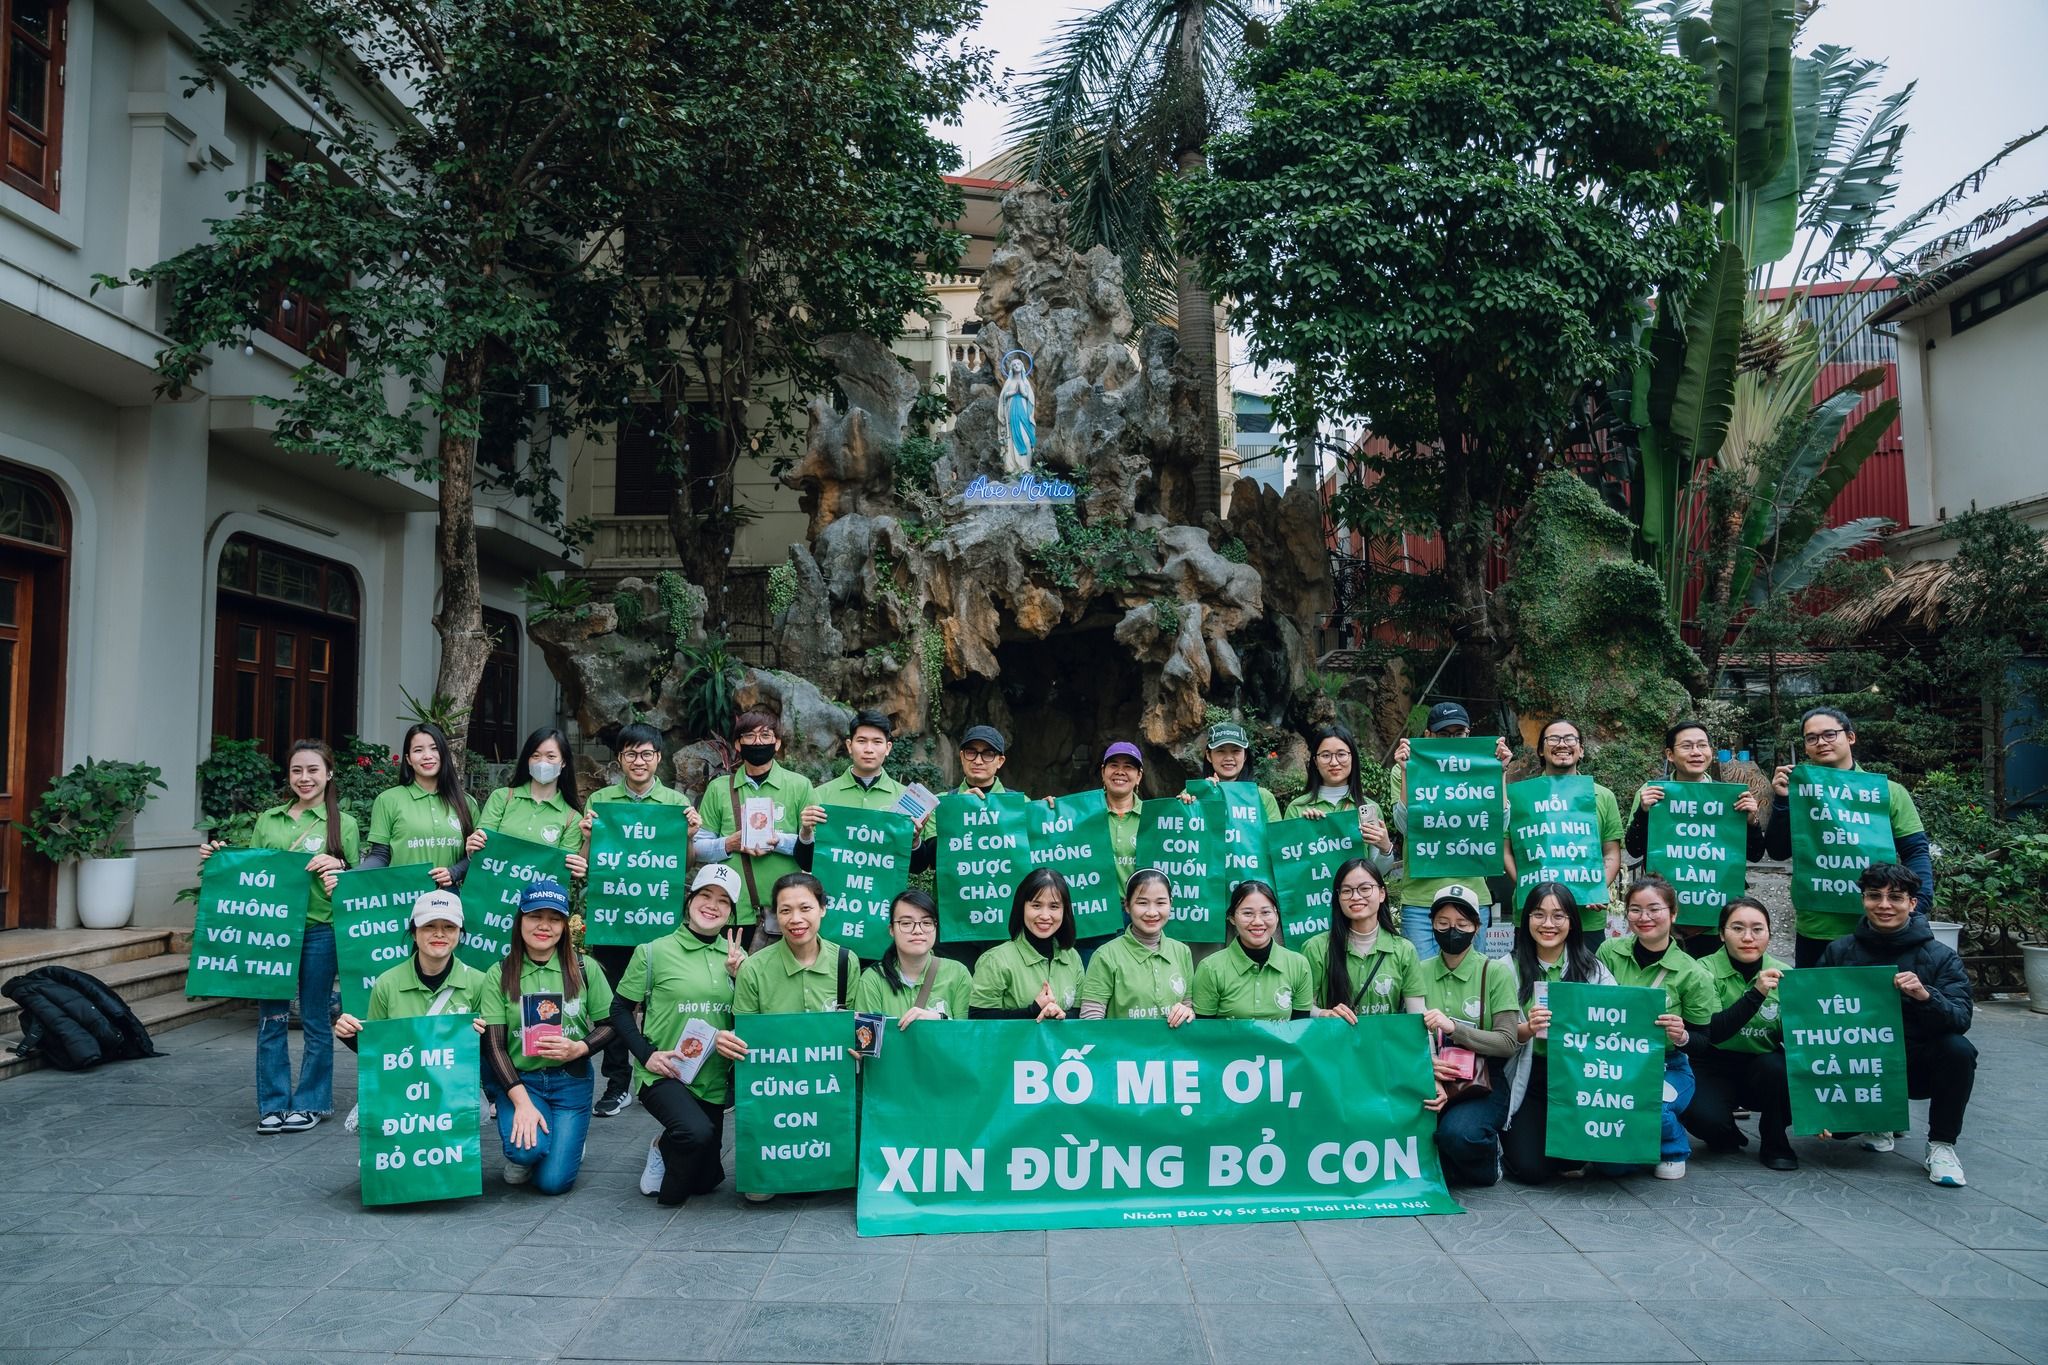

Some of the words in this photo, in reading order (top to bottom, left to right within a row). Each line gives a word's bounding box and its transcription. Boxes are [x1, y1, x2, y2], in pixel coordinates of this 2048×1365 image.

[966, 476, 1007, 498] Ave
[1012, 476, 1073, 500] Maria
[1437, 755, 1472, 772] YÊU
[1415, 785, 1439, 803] SỰ
[1445, 782, 1495, 800] SỐNG
[1799, 784, 1824, 799] MẸ
[1828, 784, 1853, 800] VÀ
[1857, 788, 1880, 803] BÉ
[1534, 794, 1568, 813] MỖI
[1670, 800, 1697, 817] MẸ
[1703, 801, 1723, 815] ƠI
[964, 808, 1001, 826] HÃY
[1232, 806, 1256, 822] MẸ
[1424, 811, 1461, 828] BẢO
[1467, 812, 1489, 830] VỆ
[1810, 803, 1832, 820] CẢ
[1837, 808, 1871, 825] HAI
[622, 822, 656, 839] YÊU
[1042, 817, 1074, 834] NÓI
[1158, 816, 1183, 833] MẸ
[1189, 815, 1204, 831] ƠI
[1517, 822, 1557, 839] THAI
[1561, 822, 1590, 835] NHI
[1676, 823, 1715, 837] CON
[846, 824, 884, 844] TÔN
[949, 831, 973, 851] ĐỂ
[977, 834, 1016, 850] CON
[1225, 829, 1241, 843] ƠI
[1822, 827, 1860, 845] ĐỀU
[1030, 844, 1092, 864] KHÔNG
[1163, 839, 1199, 853] CON
[1281, 842, 1303, 860] SỰ
[1308, 836, 1352, 855] SỐNG
[1416, 841, 1441, 859] SỰ
[1446, 838, 1496, 855] SỐNG
[1527, 844, 1546, 861] LÀ
[1550, 842, 1588, 861] MỘT
[1666, 842, 1725, 861] MUỐN
[481, 858, 508, 876] SỰ
[597, 851, 623, 870] SỰ
[627, 850, 677, 868] SỐNG
[831, 848, 894, 869] TRỌNG
[957, 859, 1011, 877] ĐƯỢC
[1153, 857, 1206, 877] MUỐN
[1816, 855, 1870, 869] QUAN
[239, 871, 275, 888] NÓI
[1312, 863, 1332, 880] LÀ
[1520, 866, 1559, 887] PHÉP
[1563, 866, 1603, 882] MÀU
[1676, 865, 1716, 883] LÀM
[603, 878, 642, 896] BẢO
[647, 880, 669, 900] VỆ
[846, 874, 873, 893] MẸ
[960, 882, 1011, 900] CHÀO
[1171, 881, 1200, 899] ÀM
[1811, 878, 1862, 896] TRỌN
[343, 894, 387, 911] THAI
[501, 889, 521, 905] LÀ
[529, 890, 566, 903] TRANSVIET
[1306, 888, 1332, 906] MỘ
[1678, 888, 1726, 906] GƯỜI
[217, 899, 288, 918] KHÔNG
[595, 909, 620, 926] SỰ
[625, 907, 674, 925] SỐNG
[826, 893, 862, 913] BẢO
[867, 900, 890, 922] VỆ
[969, 906, 1003, 923] ĐỜI
[1167, 903, 1209, 922] GƯỜI
[349, 920, 399, 938] CŨNG
[484, 912, 513, 931] MỘ
[842, 921, 864, 938] BÉ
[1289, 917, 1329, 935] MÓN
[207, 926, 241, 943] VỚI
[247, 932, 290, 949] NẠO
[371, 945, 408, 961] CON
[197, 955, 238, 972] PHÁ
[245, 960, 292, 976] THAI
[678, 999, 698, 1013] BẢO
[700, 1000, 710, 1014] VỆ
[1128, 1005, 1146, 1019] BẢO
[1817, 994, 1860, 1014] YÊU
[1588, 1007, 1626, 1026] MỌI
[1564, 1033, 1590, 1052] SỰ
[1595, 1032, 1649, 1053] SỐNG
[1792, 1026, 1894, 1045] THƯƠNG
[384, 1045, 414, 1070] BỐ
[421, 1048, 454, 1070] MẸ
[748, 1047, 797, 1063] THAI
[805, 1046, 842, 1062] NHI
[1583, 1058, 1622, 1080] ĐỀU
[1812, 1054, 1842, 1075] CẢ
[1849, 1058, 1883, 1077] MẸ
[751, 1077, 809, 1096] CŨNG
[816, 1074, 840, 1094] LÀ
[1014, 1044, 1096, 1104] BỐ
[1116, 1060, 1201, 1116] MẸ
[1222, 1055, 1302, 1108] ƠI,
[406, 1081, 429, 1101] ƠI
[1576, 1088, 1634, 1109] ĐÁNG
[1815, 1084, 1847, 1102] VÀ
[1855, 1083, 1882, 1102] BÉ
[382, 1113, 452, 1136] ĐỪNG
[774, 1112, 817, 1128] CON
[1585, 1120, 1625, 1138] QUÝ
[376, 1148, 406, 1170] BỎ
[413, 1144, 463, 1166] CON
[761, 1139, 830, 1160] NGƯỜI
[879, 1148, 985, 1193] XIN
[1007, 1134, 1184, 1191] ĐỪNG
[1208, 1128, 1286, 1186] BỎ
[1308, 1136, 1420, 1184] CON
